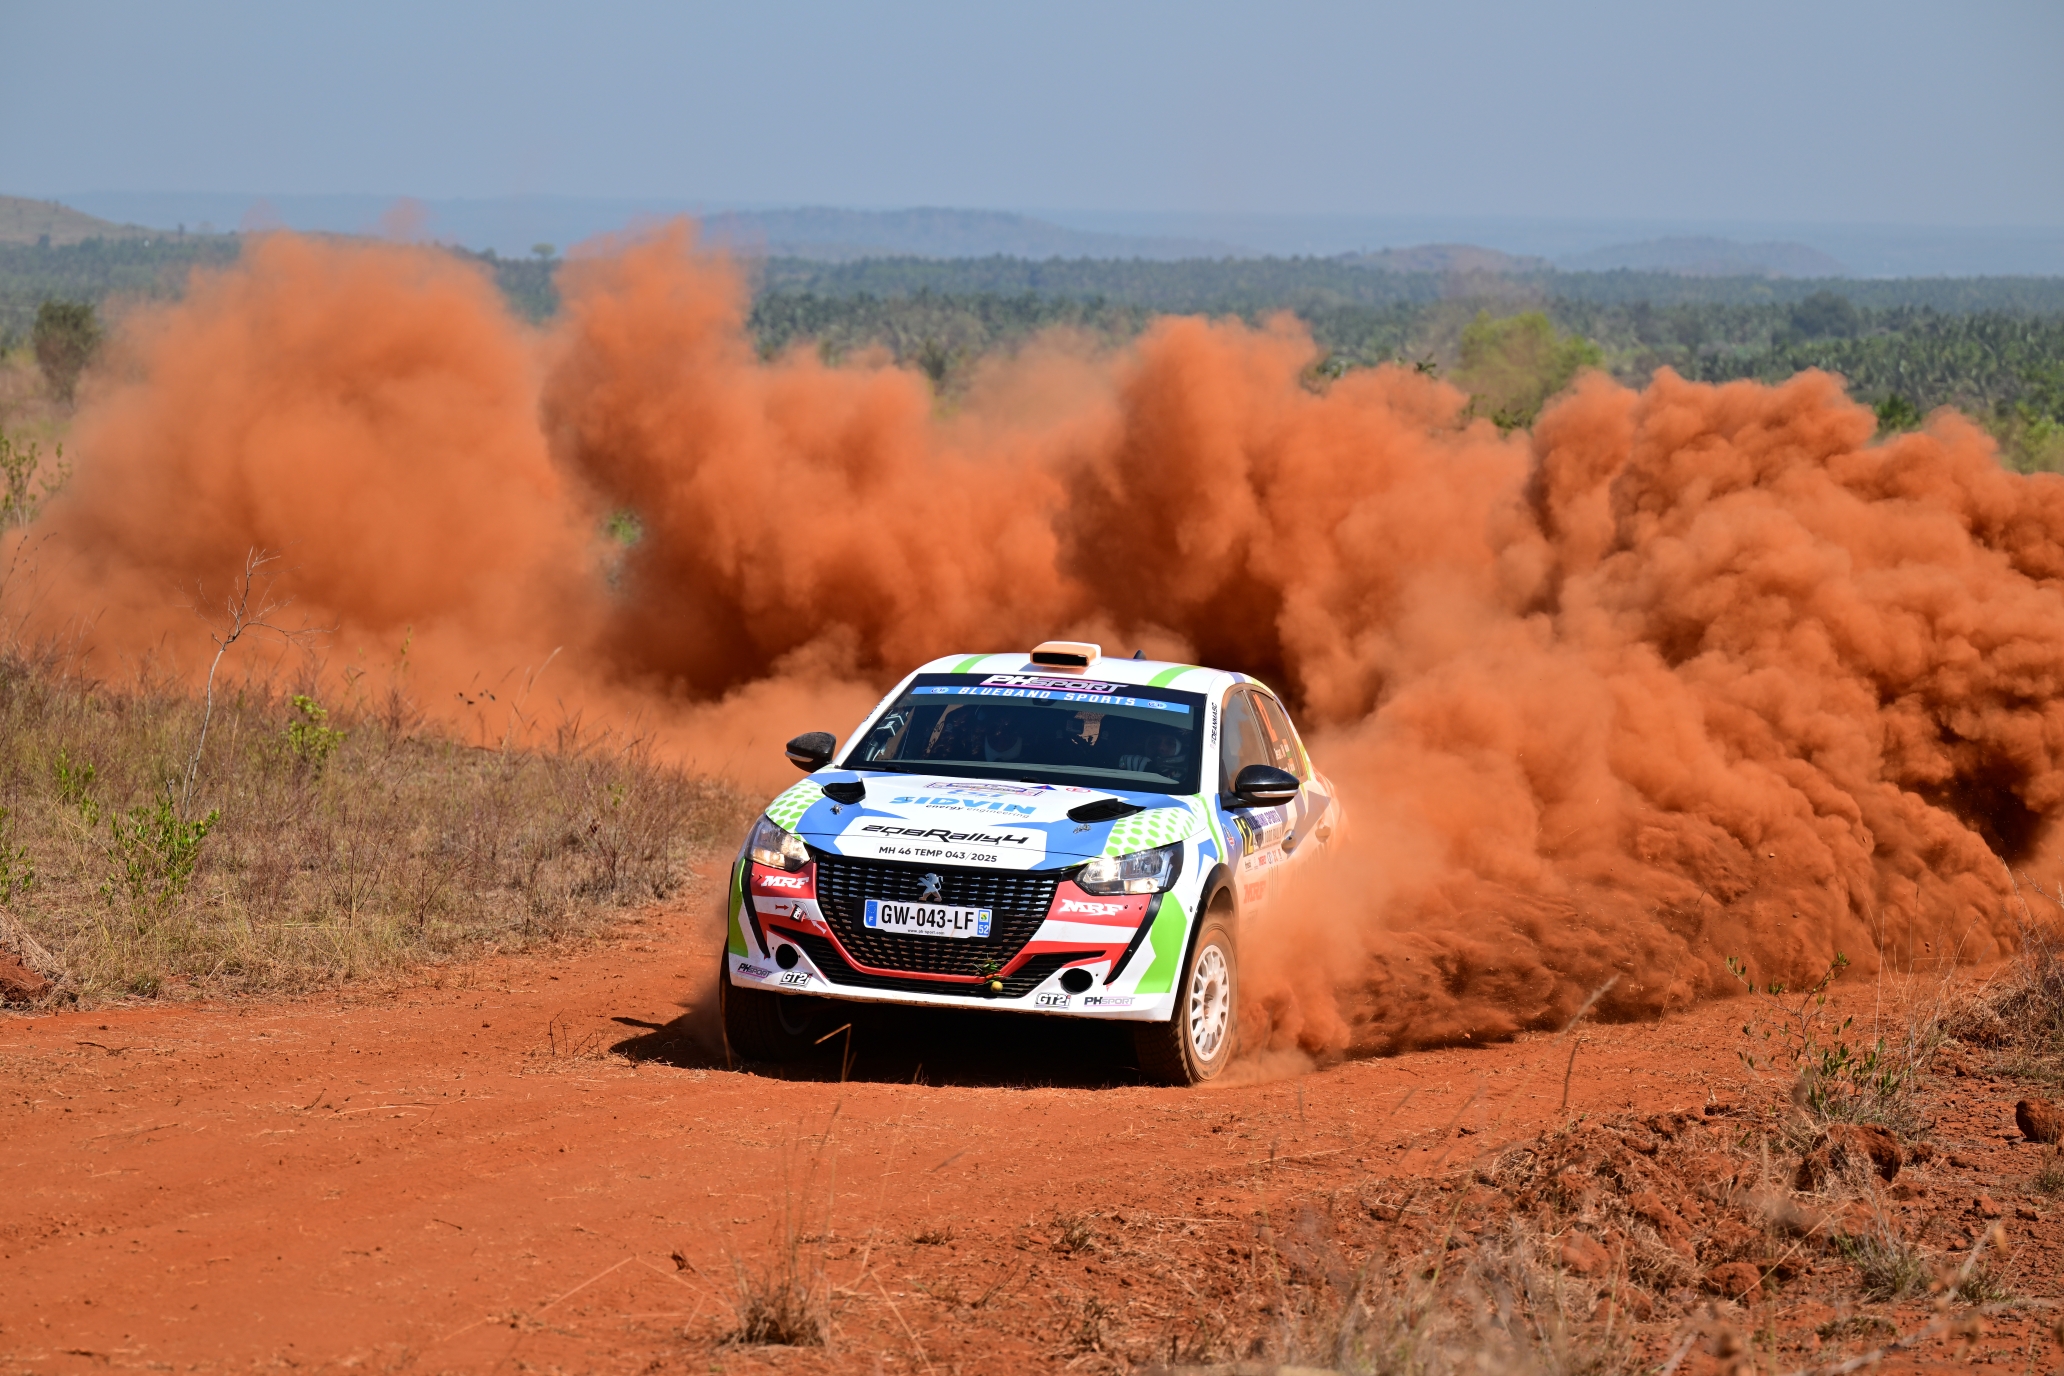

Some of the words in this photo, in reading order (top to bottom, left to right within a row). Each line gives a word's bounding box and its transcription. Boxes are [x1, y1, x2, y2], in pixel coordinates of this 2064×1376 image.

[957, 686, 1051, 699] BLUEBAND
[1063, 692, 1137, 705] SPORTS
[889, 796, 1037, 815] SIDVIN
[967, 807, 1030, 819] engineering
[878, 846, 896, 855] MH
[897, 847, 912, 855] 46
[914, 848, 943, 858] TEMP
[945, 850, 998, 862] 043/2025
[761, 875, 810, 889] MRF
[1243, 880, 1267, 904] MRF
[1058, 899, 1124, 916] MRF
[881, 904, 974, 930] GW-043-LF
[978, 924, 989, 934] 52
